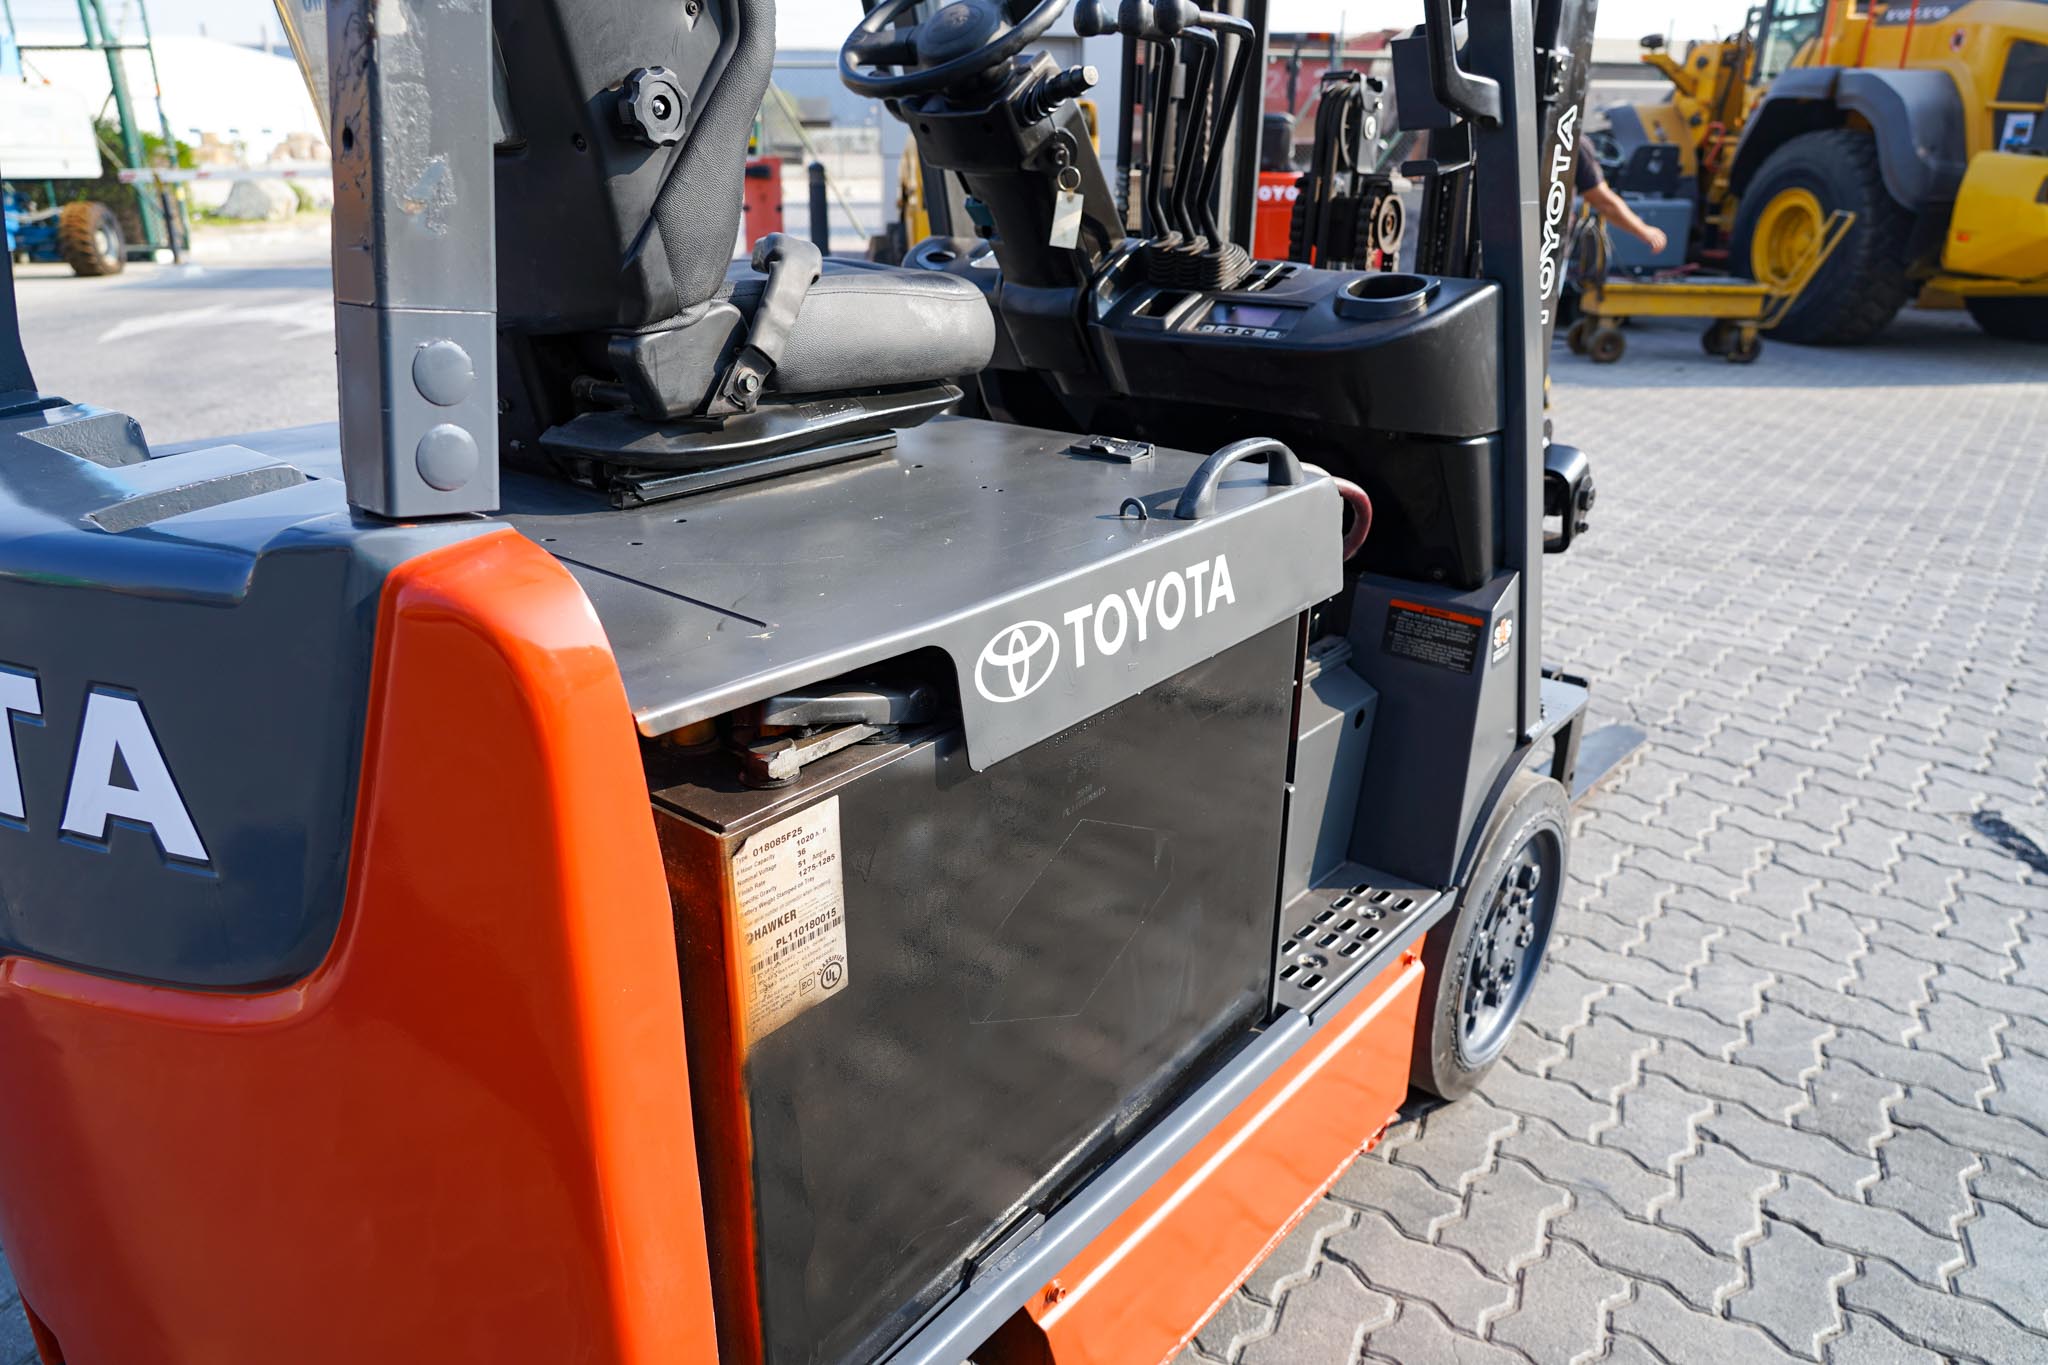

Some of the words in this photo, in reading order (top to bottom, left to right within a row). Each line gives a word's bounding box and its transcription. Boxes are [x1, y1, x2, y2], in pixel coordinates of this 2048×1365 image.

[1258, 184, 1300, 202] OYO
[1063, 553, 1236, 668] TOYOTA
[752, 826, 803, 857] 018085F25
[796, 833, 815, 847] 1020
[797, 848, 806, 857] 36
[797, 859, 806, 868] 51
[799, 853, 836, 877] 1275-1285
[754, 908, 797, 941] HAWKER
[776, 907, 837, 948] PL110180015
[825, 969, 838, 982] UL
